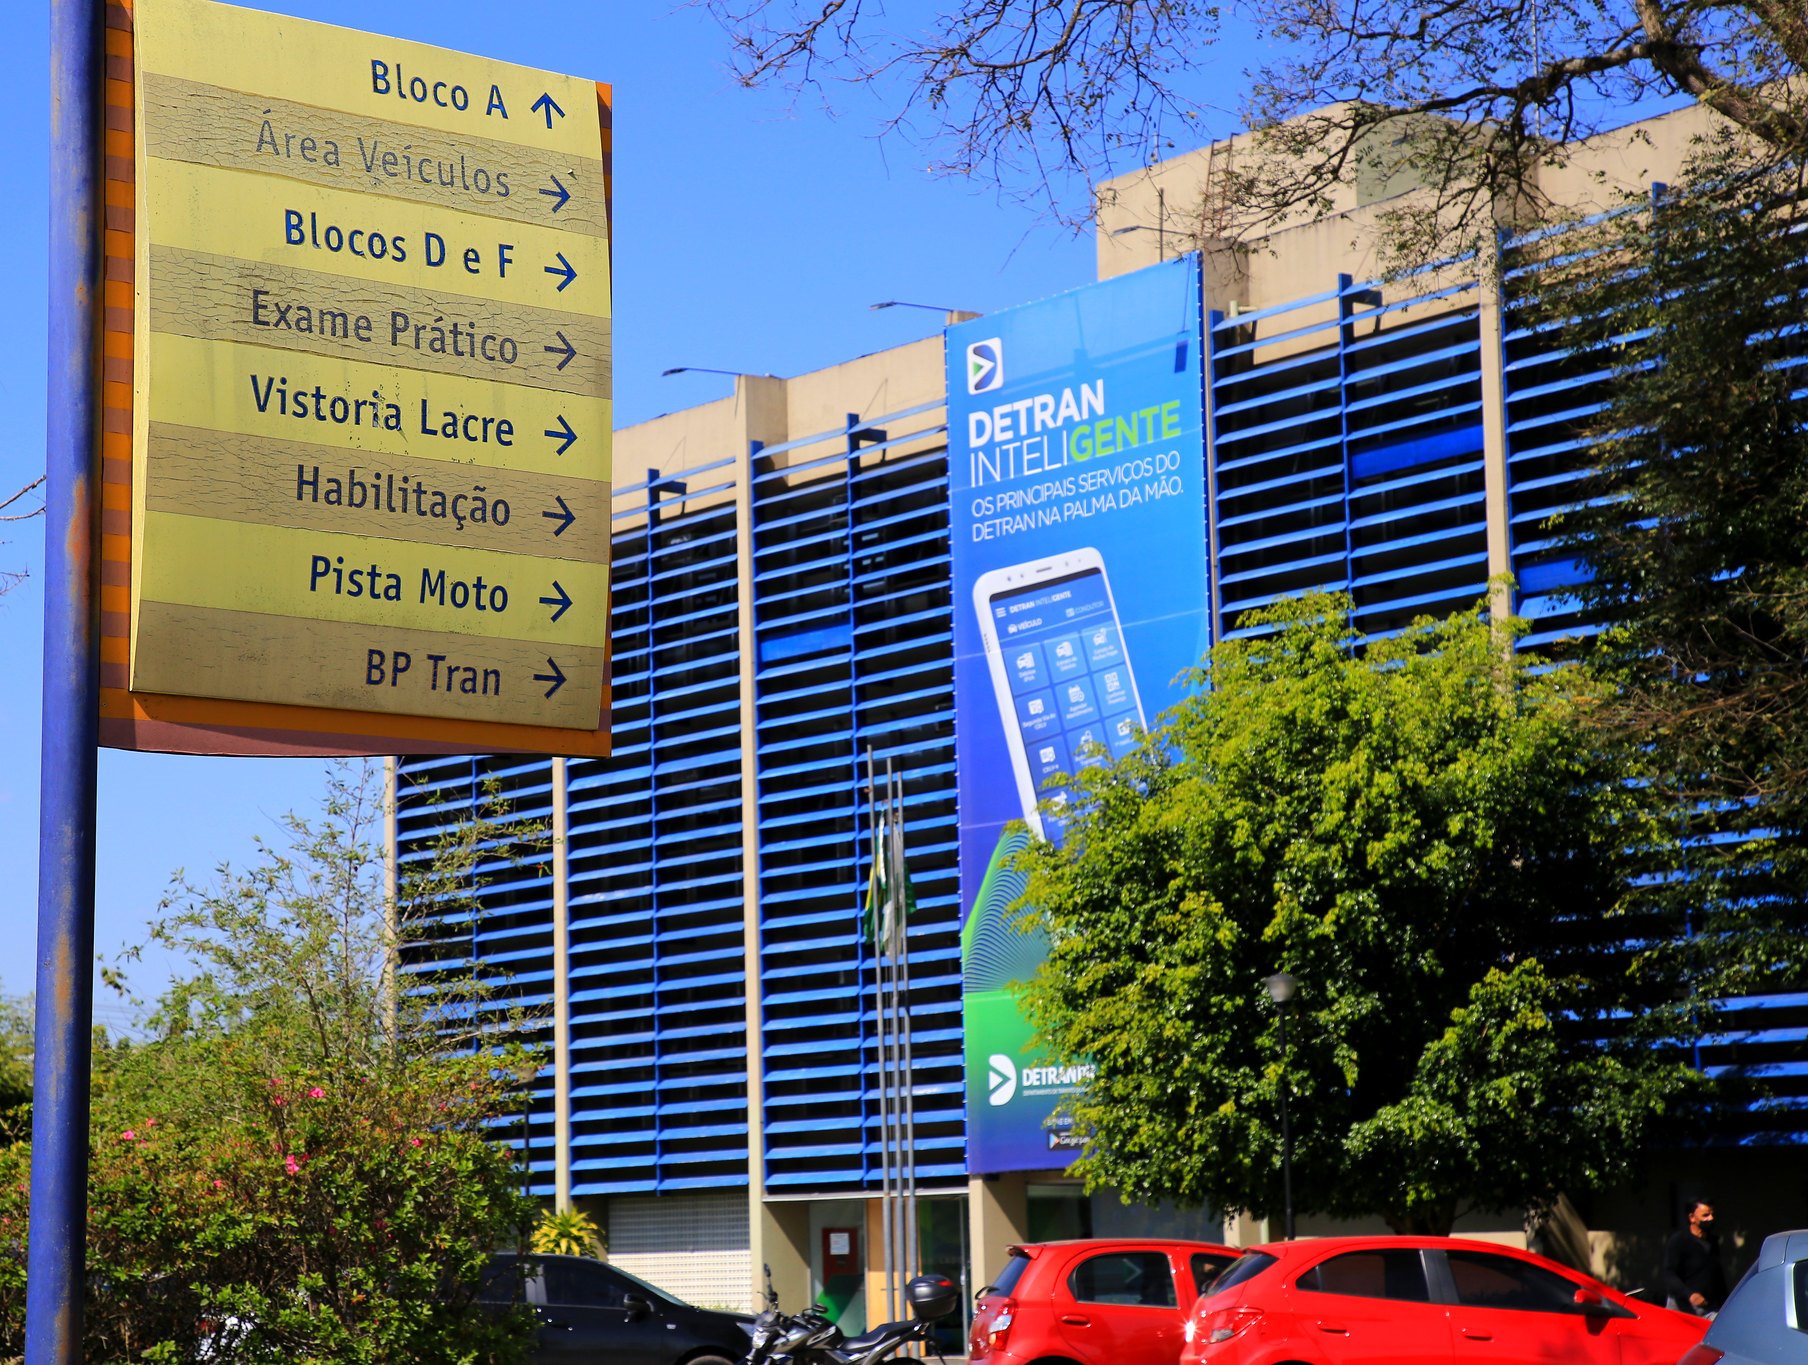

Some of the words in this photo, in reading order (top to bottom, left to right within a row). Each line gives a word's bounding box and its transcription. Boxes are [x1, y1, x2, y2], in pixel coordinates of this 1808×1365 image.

[371, 59, 469, 112] Bloco
[486, 84, 509, 120] A
[255, 108, 341, 168] Área
[356, 136, 511, 198] Veículos
[285, 208, 407, 262] Blocos
[425, 231, 446, 267] D
[463, 248, 481, 274] e
[499, 244, 514, 278] F
[252, 289, 373, 343] Exame
[390, 311, 519, 365] Prático
[250, 374, 402, 431] Vistoria
[420, 398, 515, 447] Lacre
[968, 379, 1105, 448] DETRAN
[970, 400, 1182, 488] INTELIGENTE
[296, 464, 511, 531] Habilitação
[971, 497, 995, 518] OS
[996, 477, 1076, 511] PRINCIPAIS
[1078, 457, 1154, 495] SERVIÇOS
[1155, 450, 1181, 473] DO
[972, 513, 1036, 542] DETRAN
[1037, 508, 1062, 528] NA
[1063, 494, 1117, 522] PALMA
[1119, 486, 1143, 507] DA
[1145, 475, 1184, 501] MÃO.
[309, 555, 402, 602] Pista
[419, 567, 510, 613] Moto
[1010, 601, 1035, 613] DETRAN
[1035, 591, 1071, 605] INTELIGENTE
[1018, 618, 1042, 630] VEÍCULO
[365, 648, 412, 687] BP
[427, 655, 501, 696] Tran
